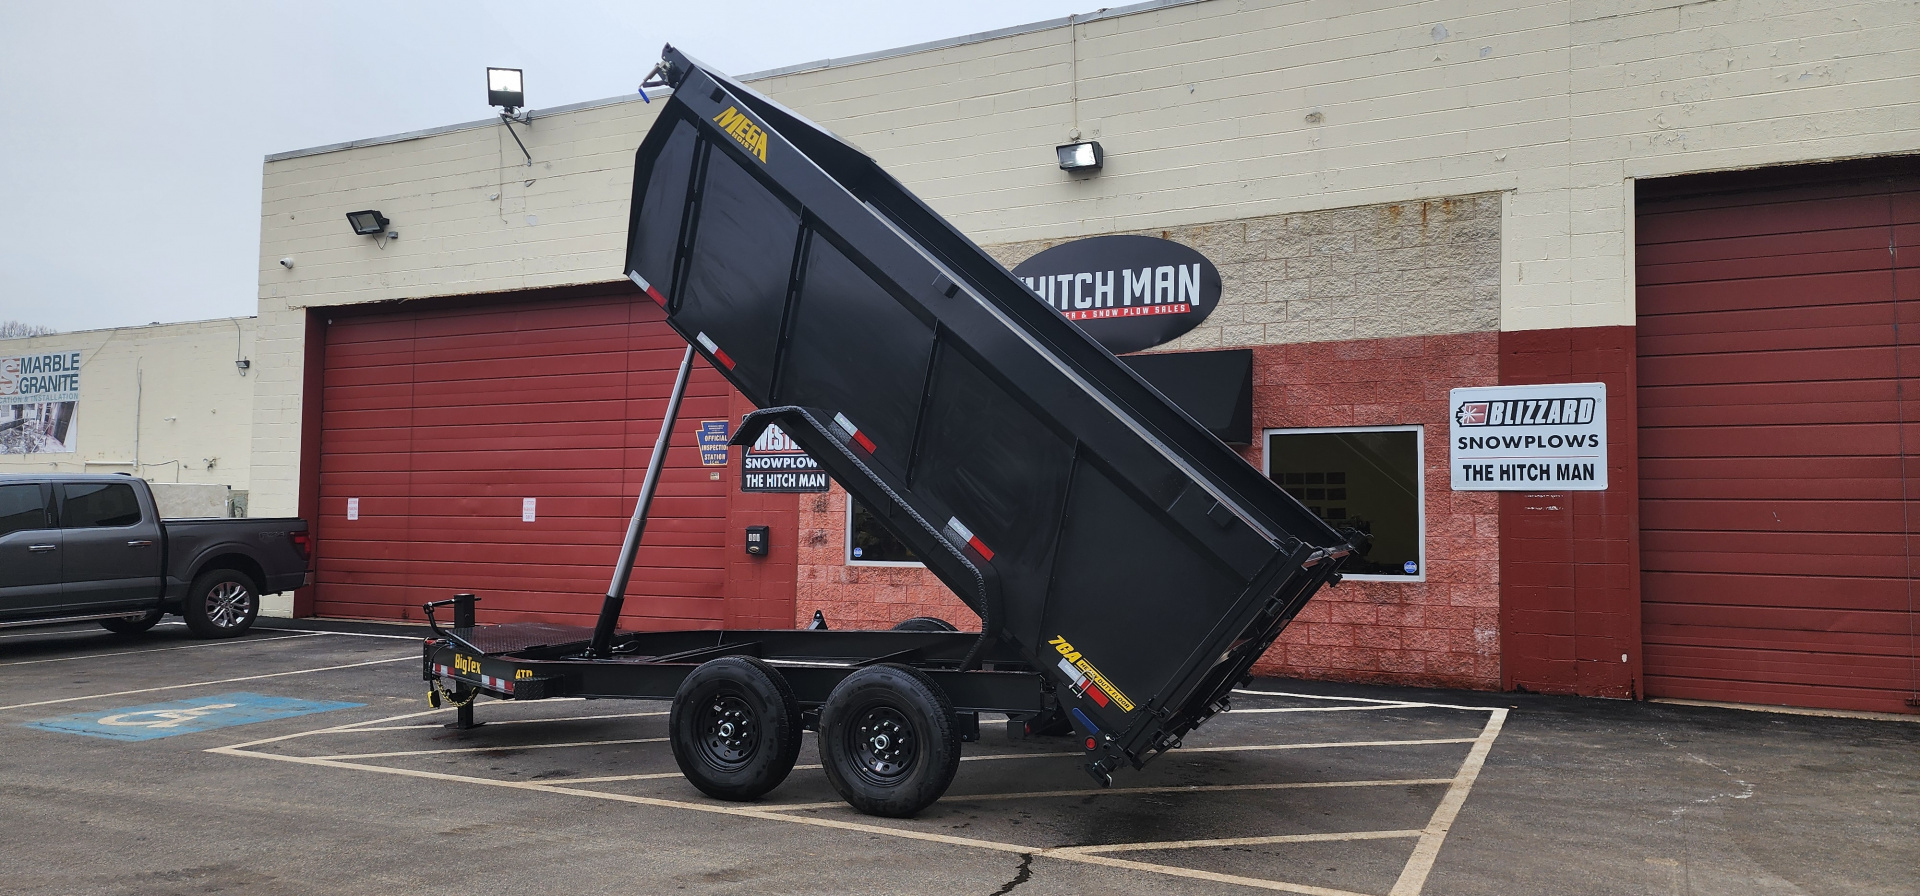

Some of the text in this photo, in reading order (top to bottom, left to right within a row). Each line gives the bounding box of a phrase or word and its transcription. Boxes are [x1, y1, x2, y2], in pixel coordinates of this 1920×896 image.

[713, 106, 768, 164] MEGA
[731, 131, 755, 151] HOIST
[1025, 263, 1201, 310] HITCH MAN
[1093, 309, 1118, 317] SNOW
[1123, 306, 1149, 315] PLOW
[1155, 304, 1186, 313] SALES
[20, 353, 80, 374] MARBLE
[19, 374, 79, 394] GRANITE
[30, 393, 79, 401] INSTALLATION
[1489, 398, 1594, 425] BLIZZARD
[1458, 434, 1599, 450] SNOWPLOWS
[745, 458, 818, 469] SNOWPLOW
[1463, 463, 1595, 482] THE HITCH MAN
[746, 473, 825, 488] THE HITCH MAN
[1048, 634, 1083, 663] 7GA
[454, 653, 481, 675] BigTex
[1097, 678, 1113, 692] DUTY
[1111, 692, 1130, 709] FLOOR
